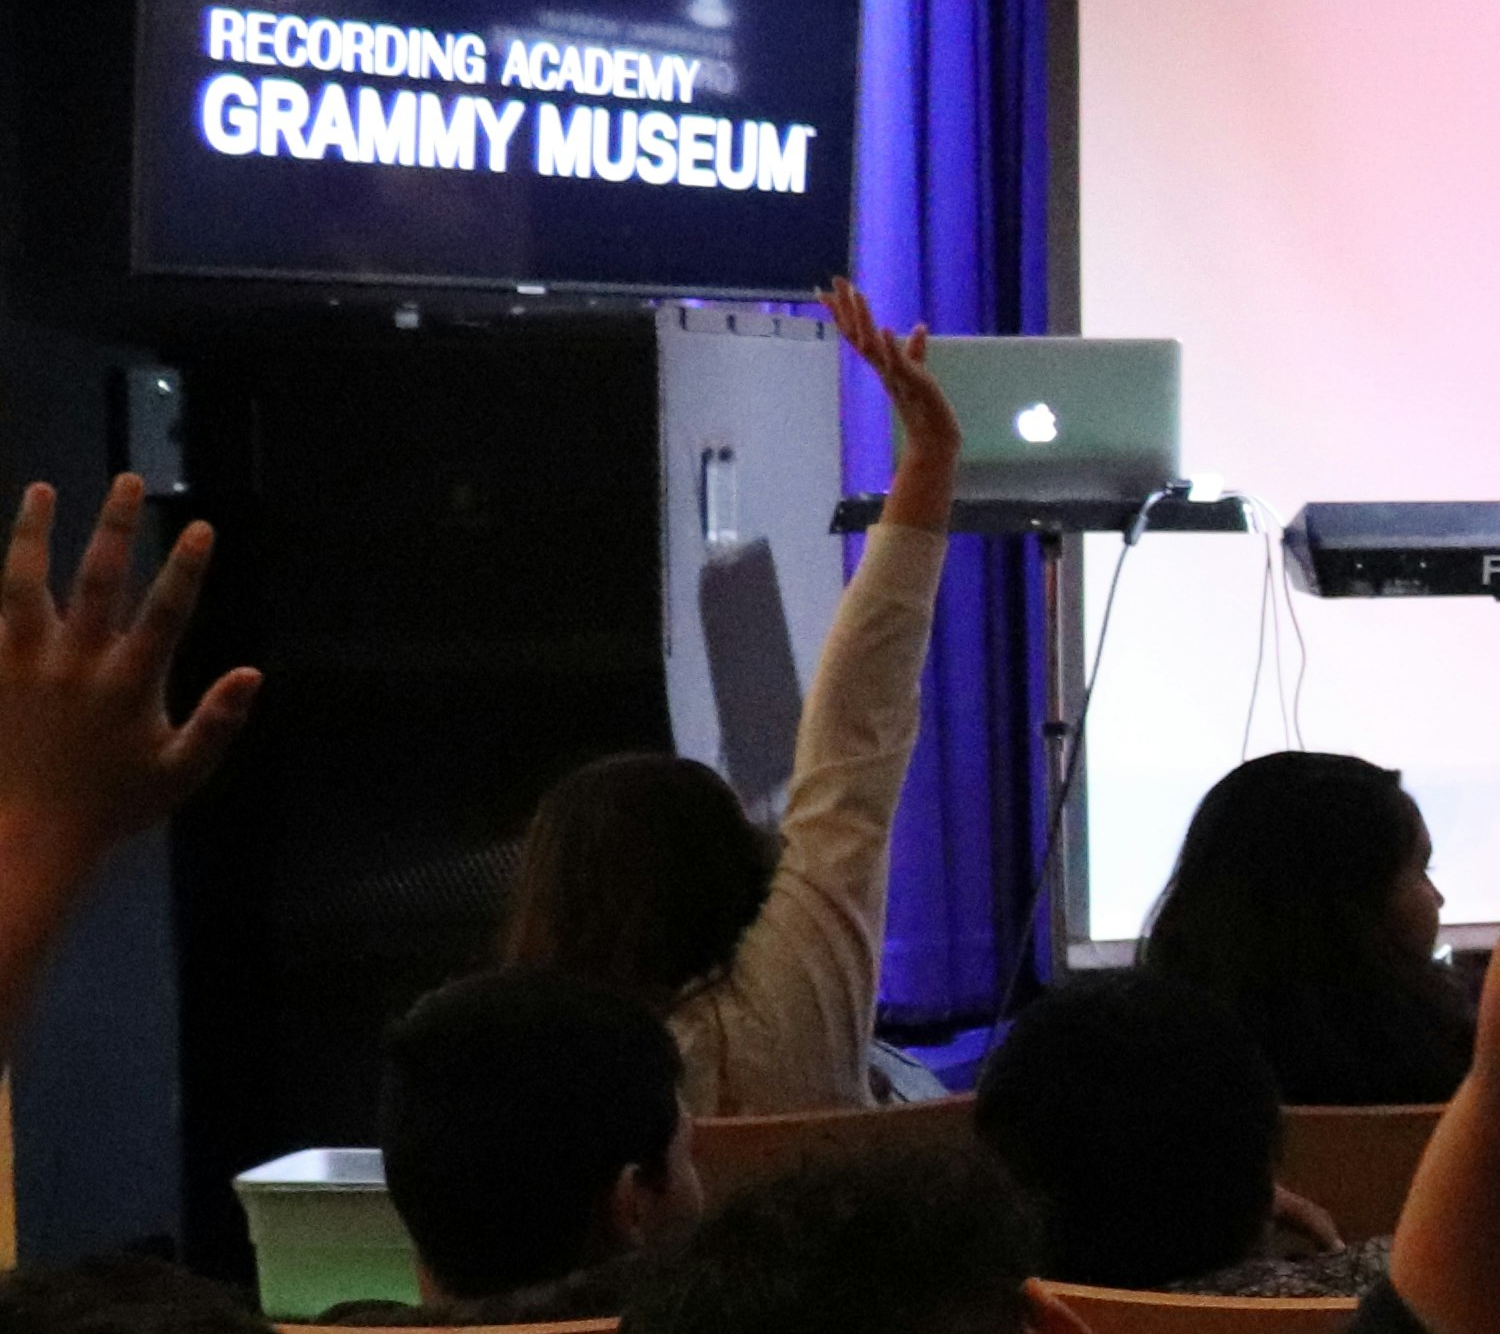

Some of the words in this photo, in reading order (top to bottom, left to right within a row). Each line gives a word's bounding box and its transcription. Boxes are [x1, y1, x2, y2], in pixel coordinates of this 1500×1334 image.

[209, 8, 486, 85] RECORDING
[501, 39, 700, 103] ACADEMY
[203, 73, 525, 172] GRAMMY
